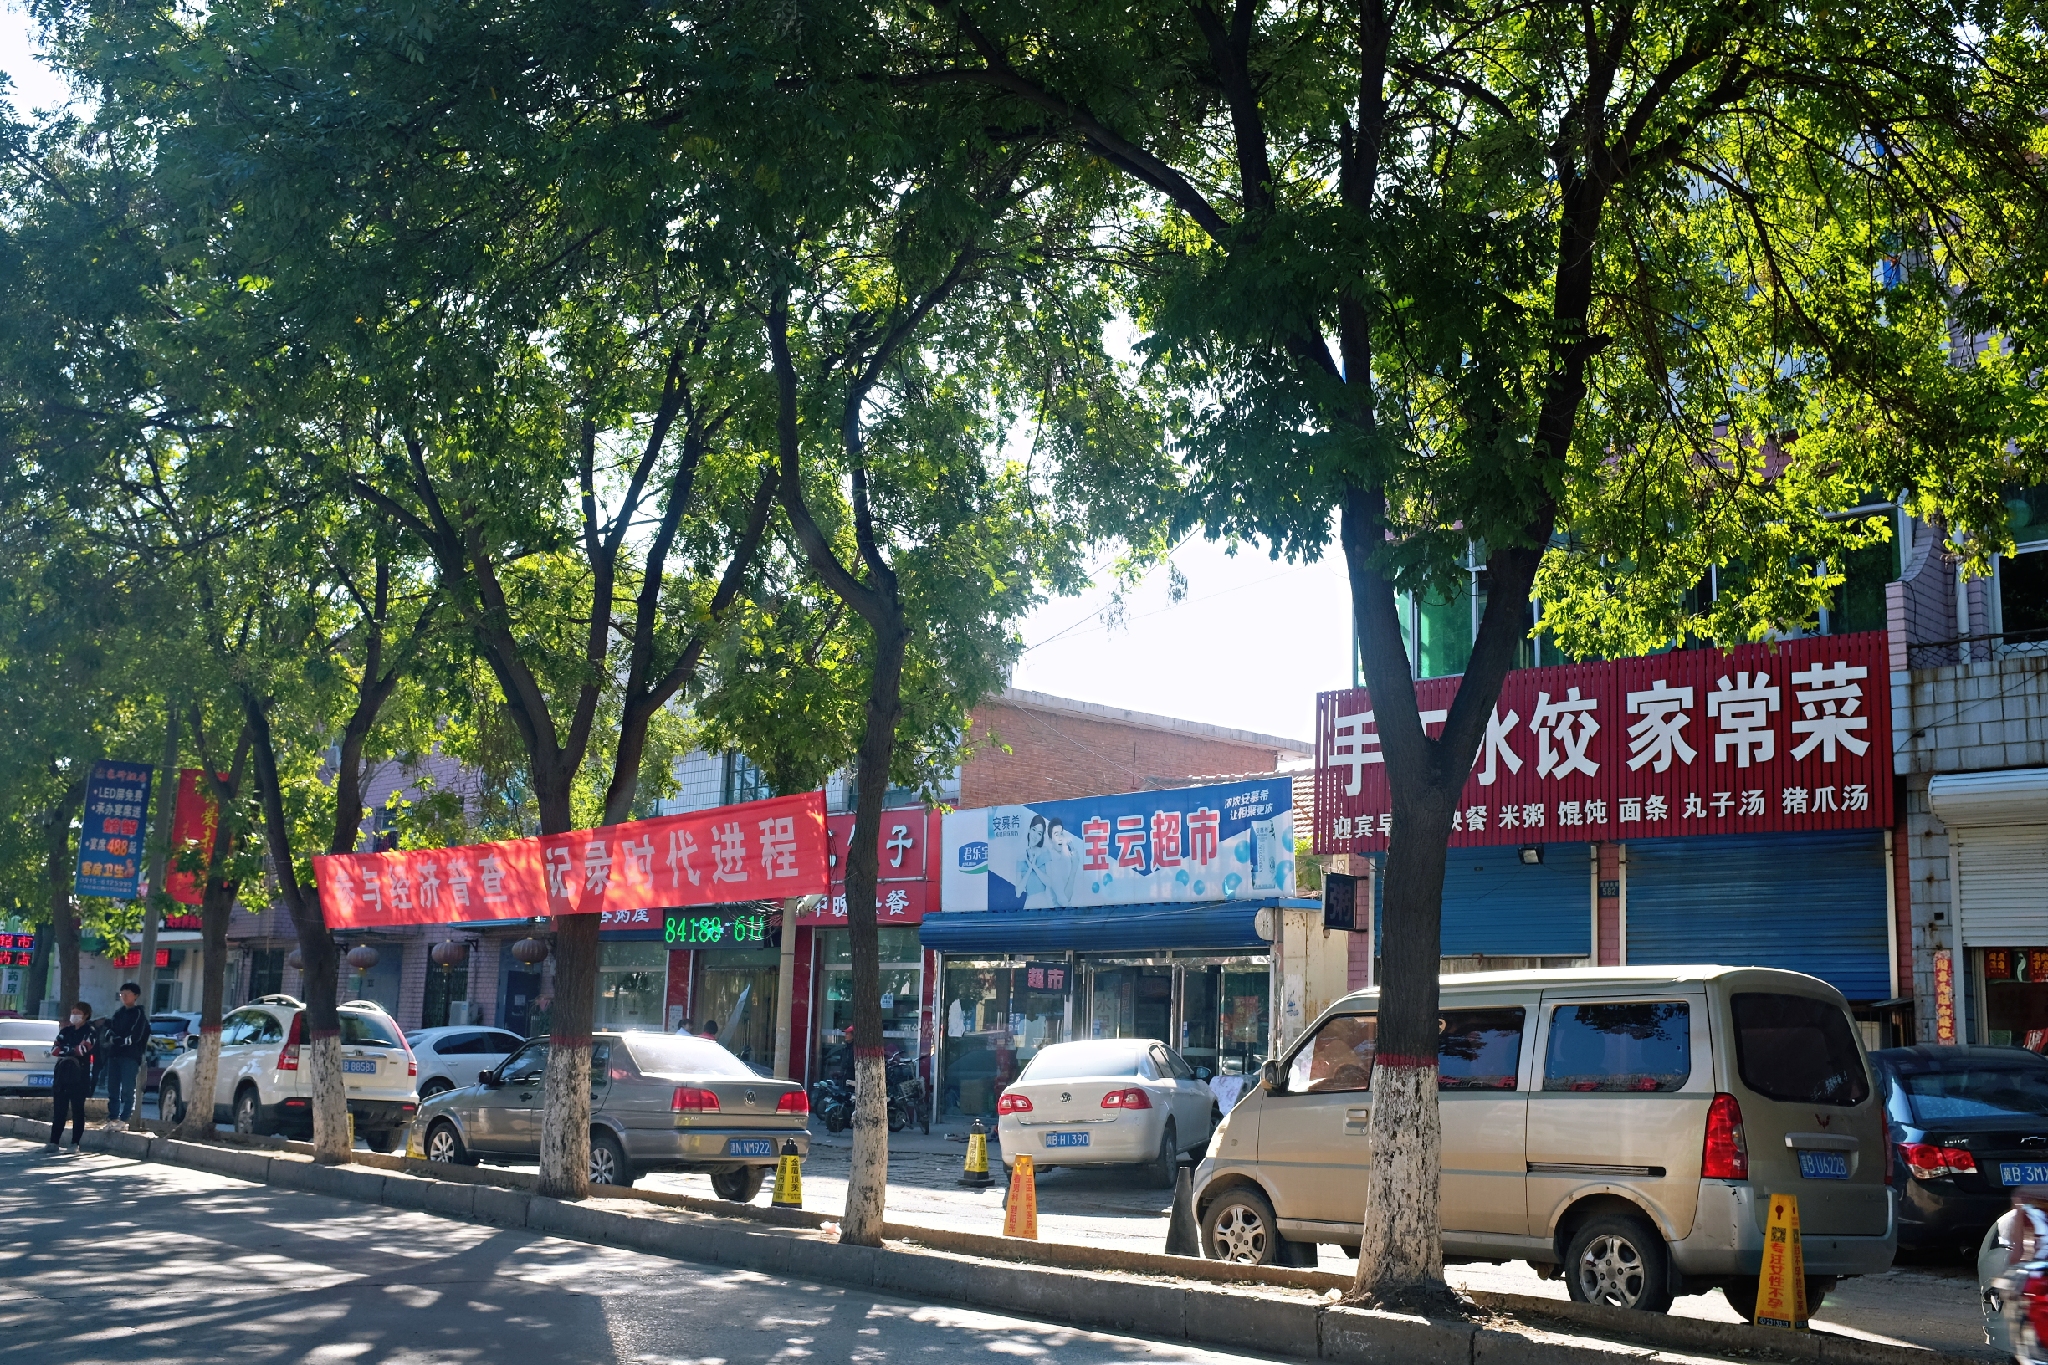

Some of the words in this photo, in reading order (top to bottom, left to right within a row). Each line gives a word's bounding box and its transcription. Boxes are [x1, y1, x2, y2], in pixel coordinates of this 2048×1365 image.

[1626, 661, 1871, 773] 家常菜
[992, 814, 1020, 831] 安慕希
[1498, 803, 1545, 829] 米粥
[1558, 799, 1608, 827] 馄饨
[1619, 794, 1668, 822] 面条
[1682, 789, 1765, 819] 丸子汤
[1782, 784, 1869, 815] 猪爪汤
[334, 855, 508, 914] 参与经济普查
[545, 816, 799, 899] 记录时代进程
[1081, 808, 1219, 872] 宝云超市
[1027, 968, 1065, 990] 超市
[1767, 1242, 1786, 1309] 专注女性不孕
